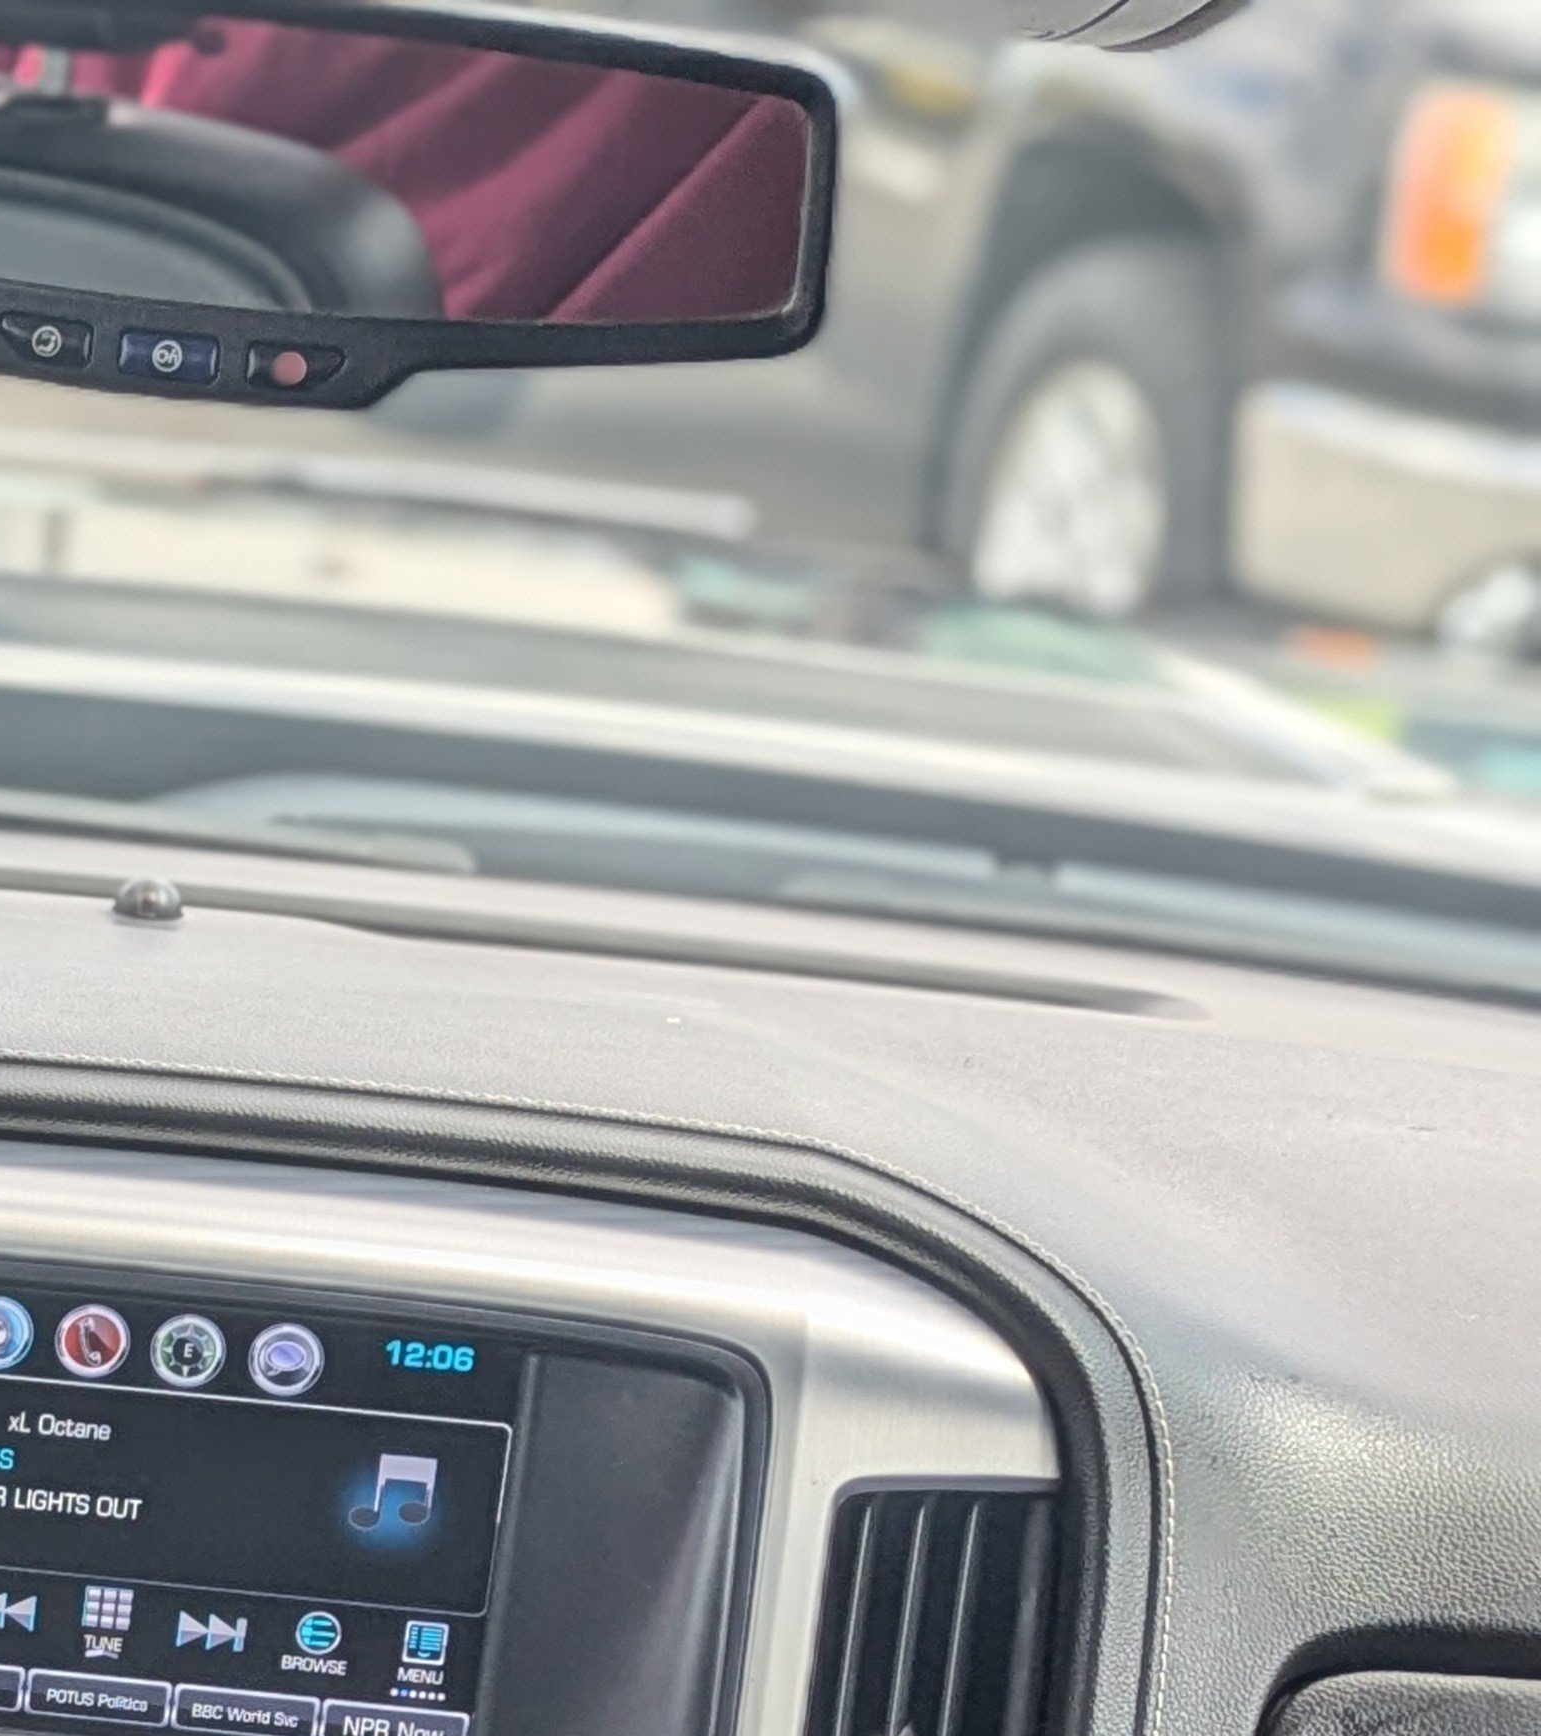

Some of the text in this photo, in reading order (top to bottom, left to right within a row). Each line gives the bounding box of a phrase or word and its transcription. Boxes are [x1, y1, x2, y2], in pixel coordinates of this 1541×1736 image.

[384, 1338, 475, 1373] 12:06
[38, 1413, 112, 1441] Octane
[14, 1487, 91, 1516] LIGHTS
[96, 1496, 144, 1521] OUT
[83, 1634, 124, 1653] TUNE
[281, 1654, 348, 1677] BROWSE
[397, 1666, 445, 1686] MENU
[46, 1687, 95, 1708] POTUS
[191, 1702, 300, 1729] BBC World Svc
